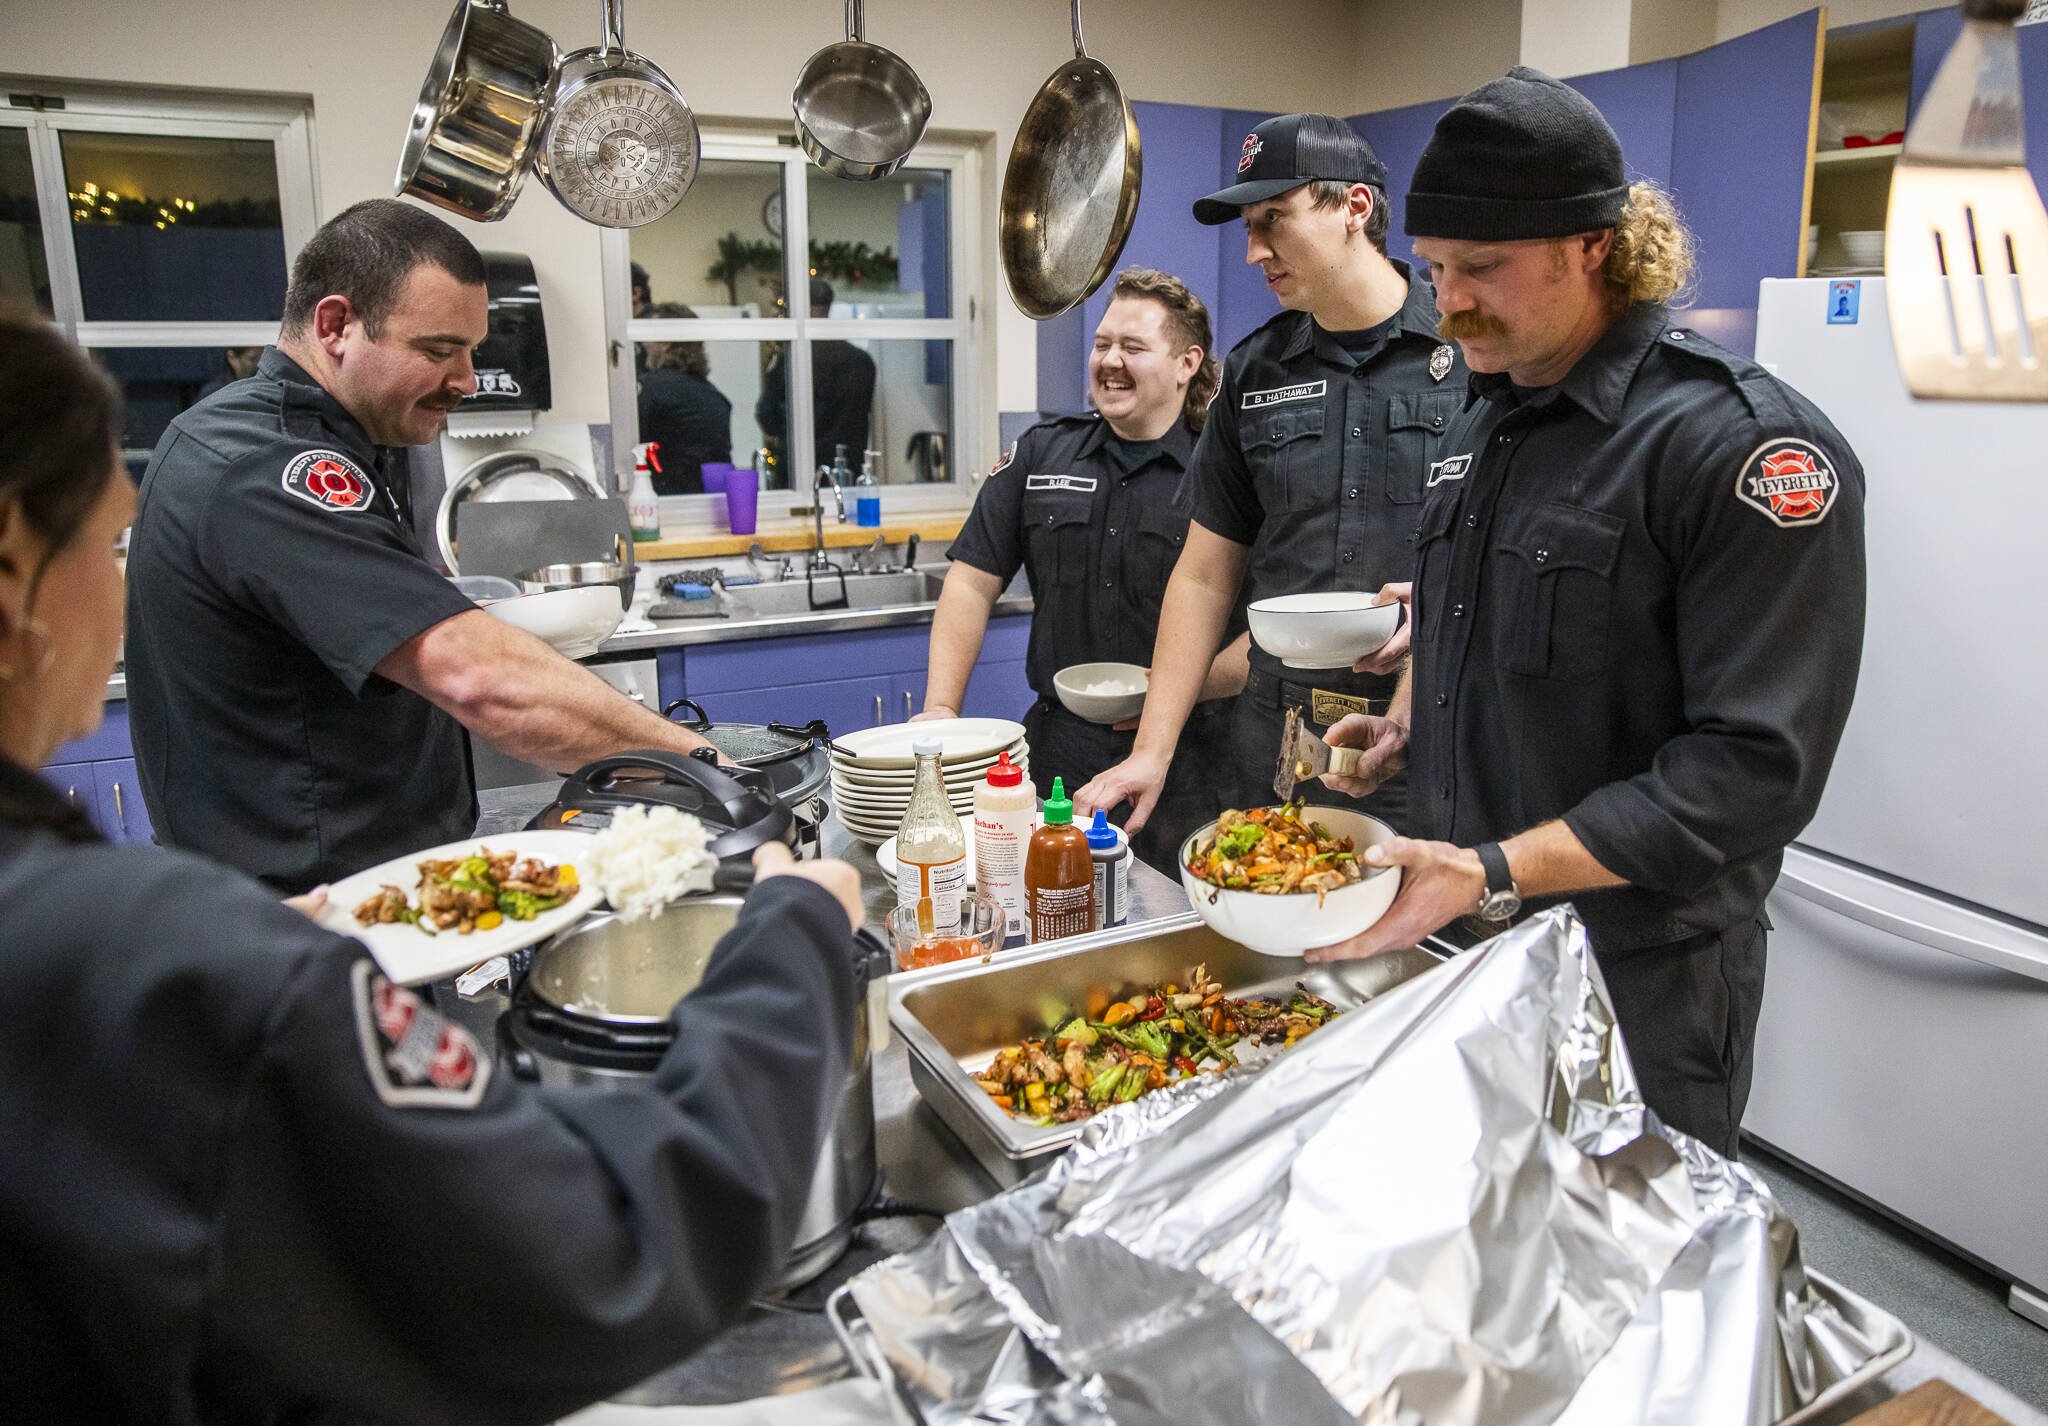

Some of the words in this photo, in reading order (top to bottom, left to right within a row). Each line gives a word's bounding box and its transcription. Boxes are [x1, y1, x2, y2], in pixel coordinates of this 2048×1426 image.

[1254, 395, 1264, 404] B.
[1266, 386, 1314, 402] HATHAWAY
[1761, 474, 1823, 494] EVERETT
